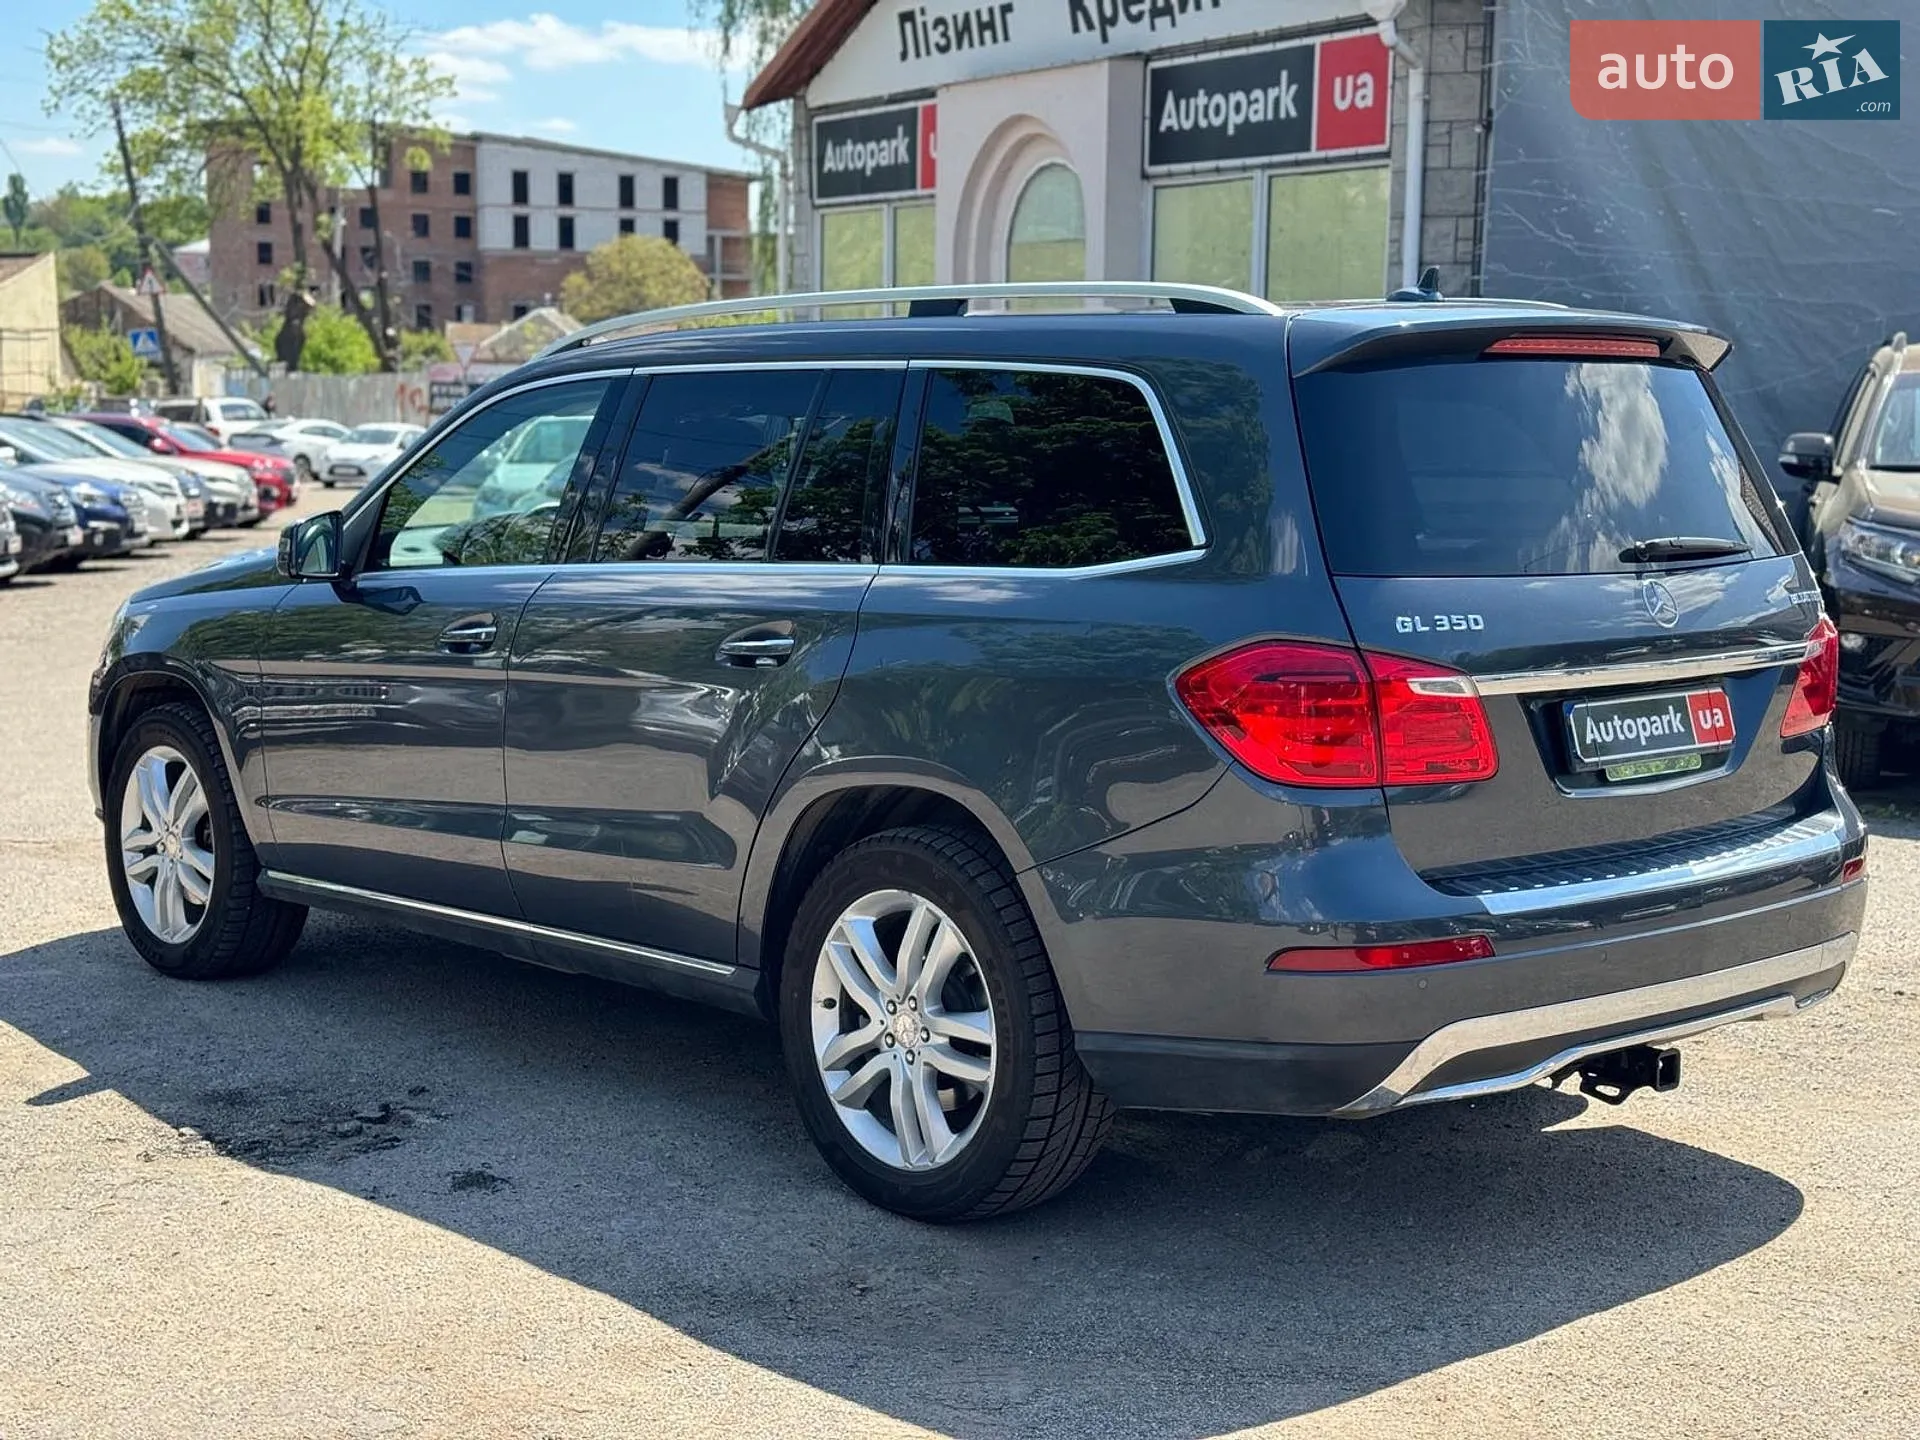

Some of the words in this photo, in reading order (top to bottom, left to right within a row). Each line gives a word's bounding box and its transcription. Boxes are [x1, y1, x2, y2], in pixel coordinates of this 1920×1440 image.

[897, 3, 1014, 61] Лізинг
[1068, 0, 1221, 44] Кред
[1158, 69, 1299, 136] Autopark
[1332, 71, 1375, 112] ua
[822, 123, 910, 177] Autopark
[1395, 615, 1430, 633] GL
[1433, 614, 1485, 631] 350
[1585, 705, 1686, 746] Autopark
[1698, 707, 1726, 731] ua
